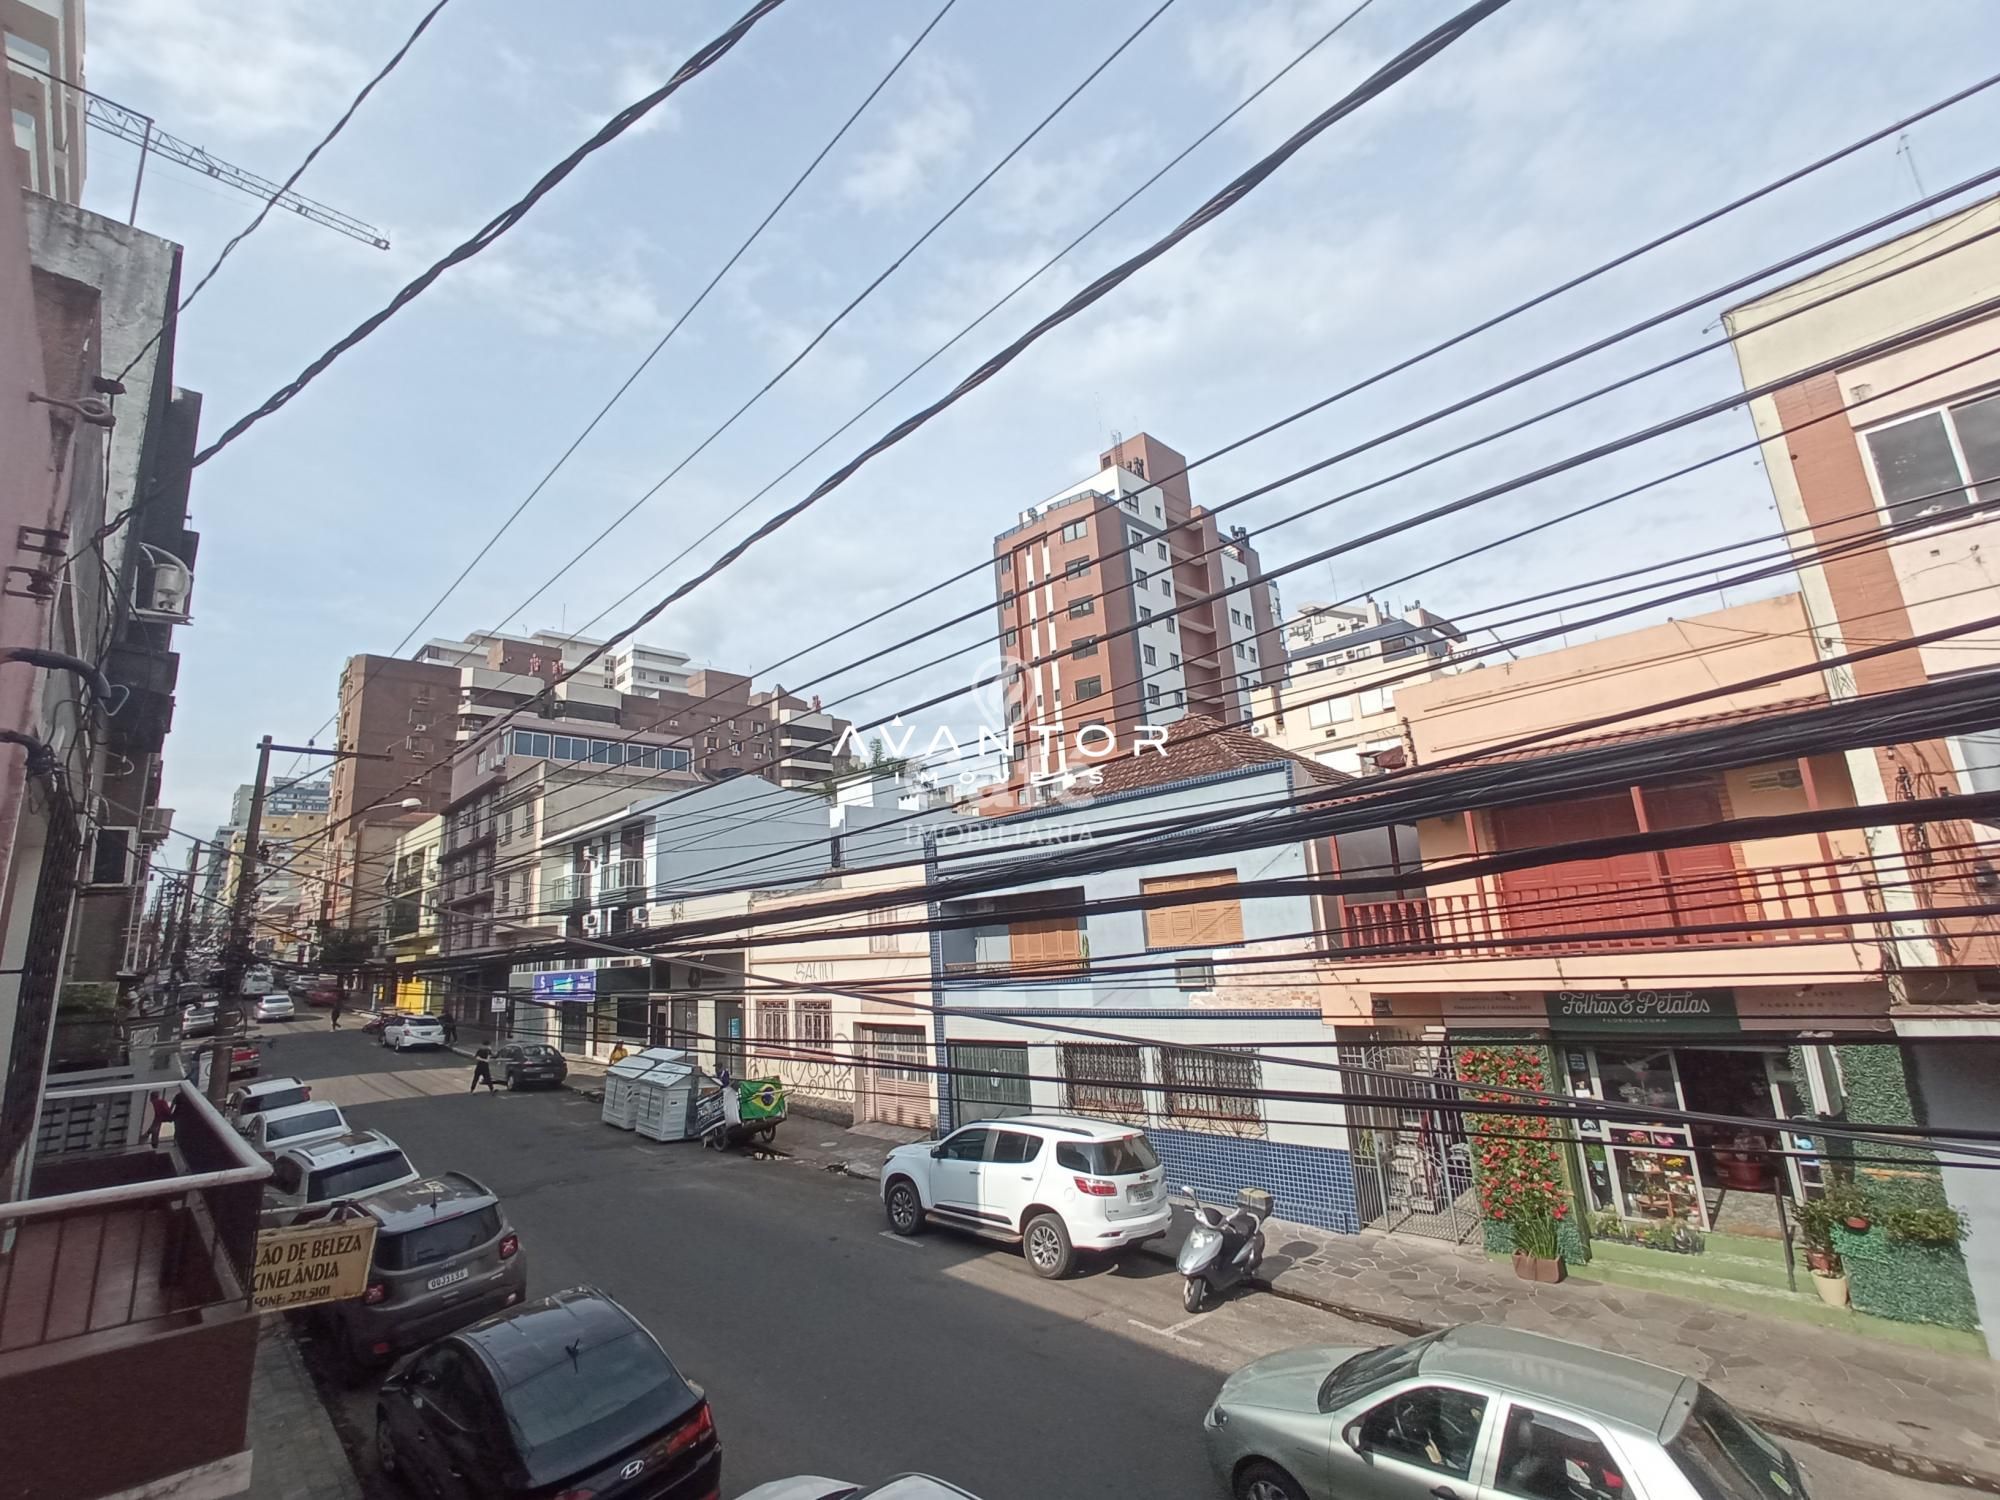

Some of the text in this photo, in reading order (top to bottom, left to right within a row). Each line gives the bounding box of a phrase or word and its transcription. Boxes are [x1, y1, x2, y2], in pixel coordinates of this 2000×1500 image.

[1559, 991, 1617, 1015] Folhas
[286, 1242, 308, 1263] DE
[311, 1234, 362, 1259] BELEZA
[252, 1261, 340, 1292] CINELÂNDIA
